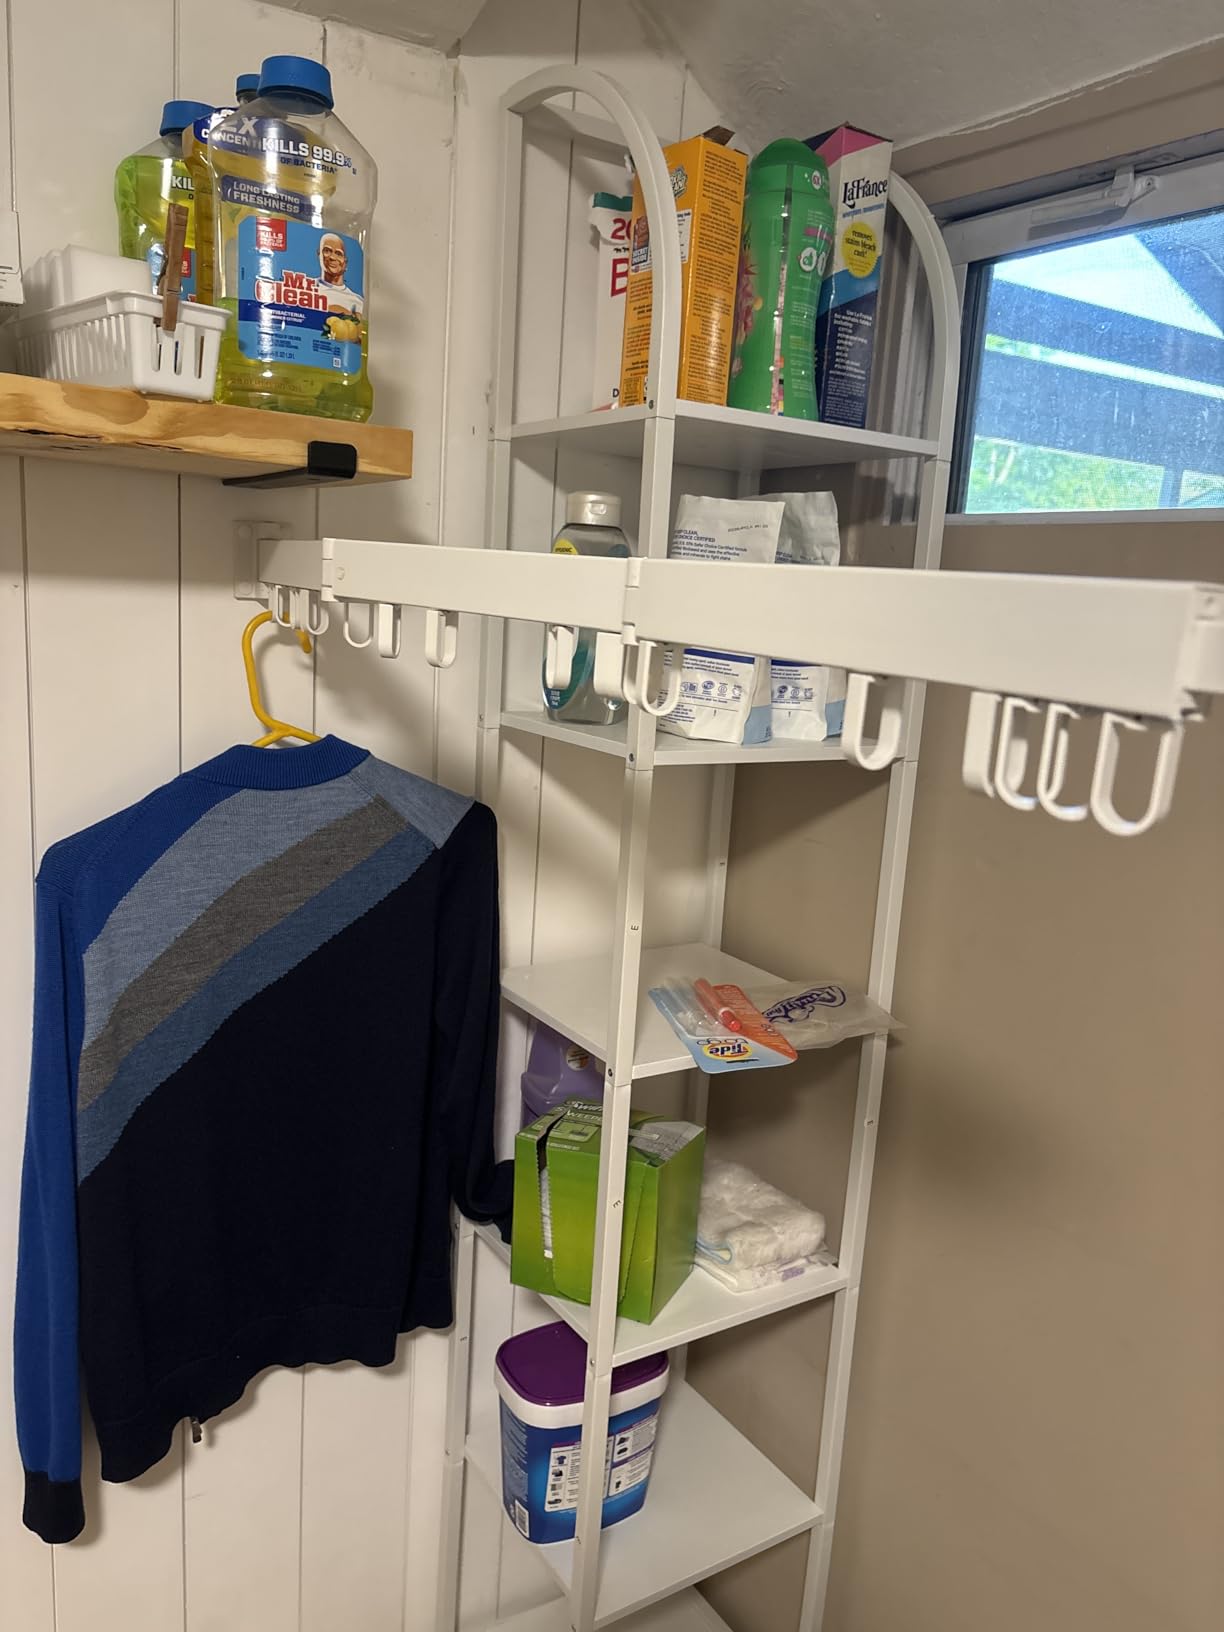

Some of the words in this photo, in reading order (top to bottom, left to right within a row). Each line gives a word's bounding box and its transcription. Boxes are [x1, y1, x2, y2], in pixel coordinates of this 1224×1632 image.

[262, 137, 310, 158] KILLS
[171, 176, 195, 192] KIL
[233, 181, 261, 195] LONG
[233, 194, 300, 214] FRESHNESS
[282, 270, 320, 293] Mr.
[255, 279, 329, 312] Clean
[709, 1043, 749, 1056] Tide
